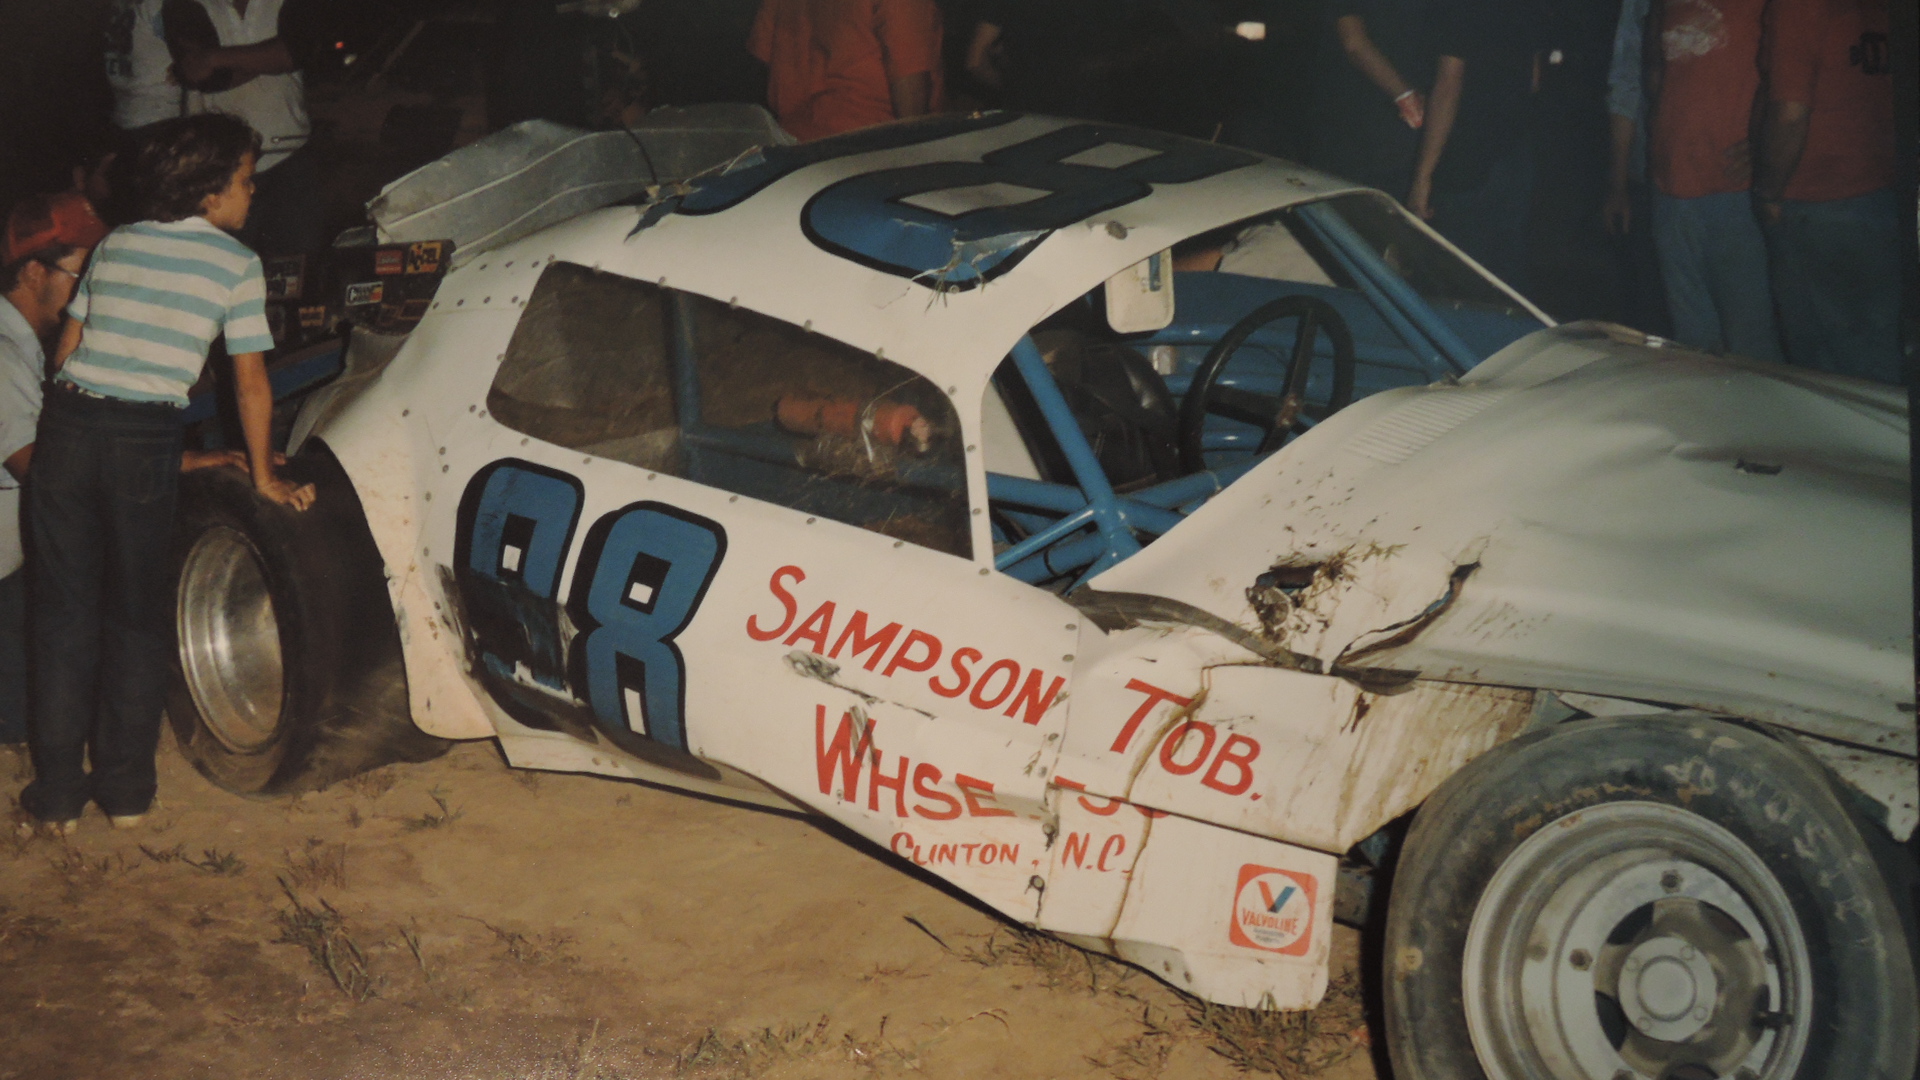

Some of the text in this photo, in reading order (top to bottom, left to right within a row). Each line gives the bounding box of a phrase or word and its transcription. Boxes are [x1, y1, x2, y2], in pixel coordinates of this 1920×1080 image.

[746, 565, 1263, 802] SAMPSON TOB.
[1242, 908, 1300, 935] VALVOLINE
